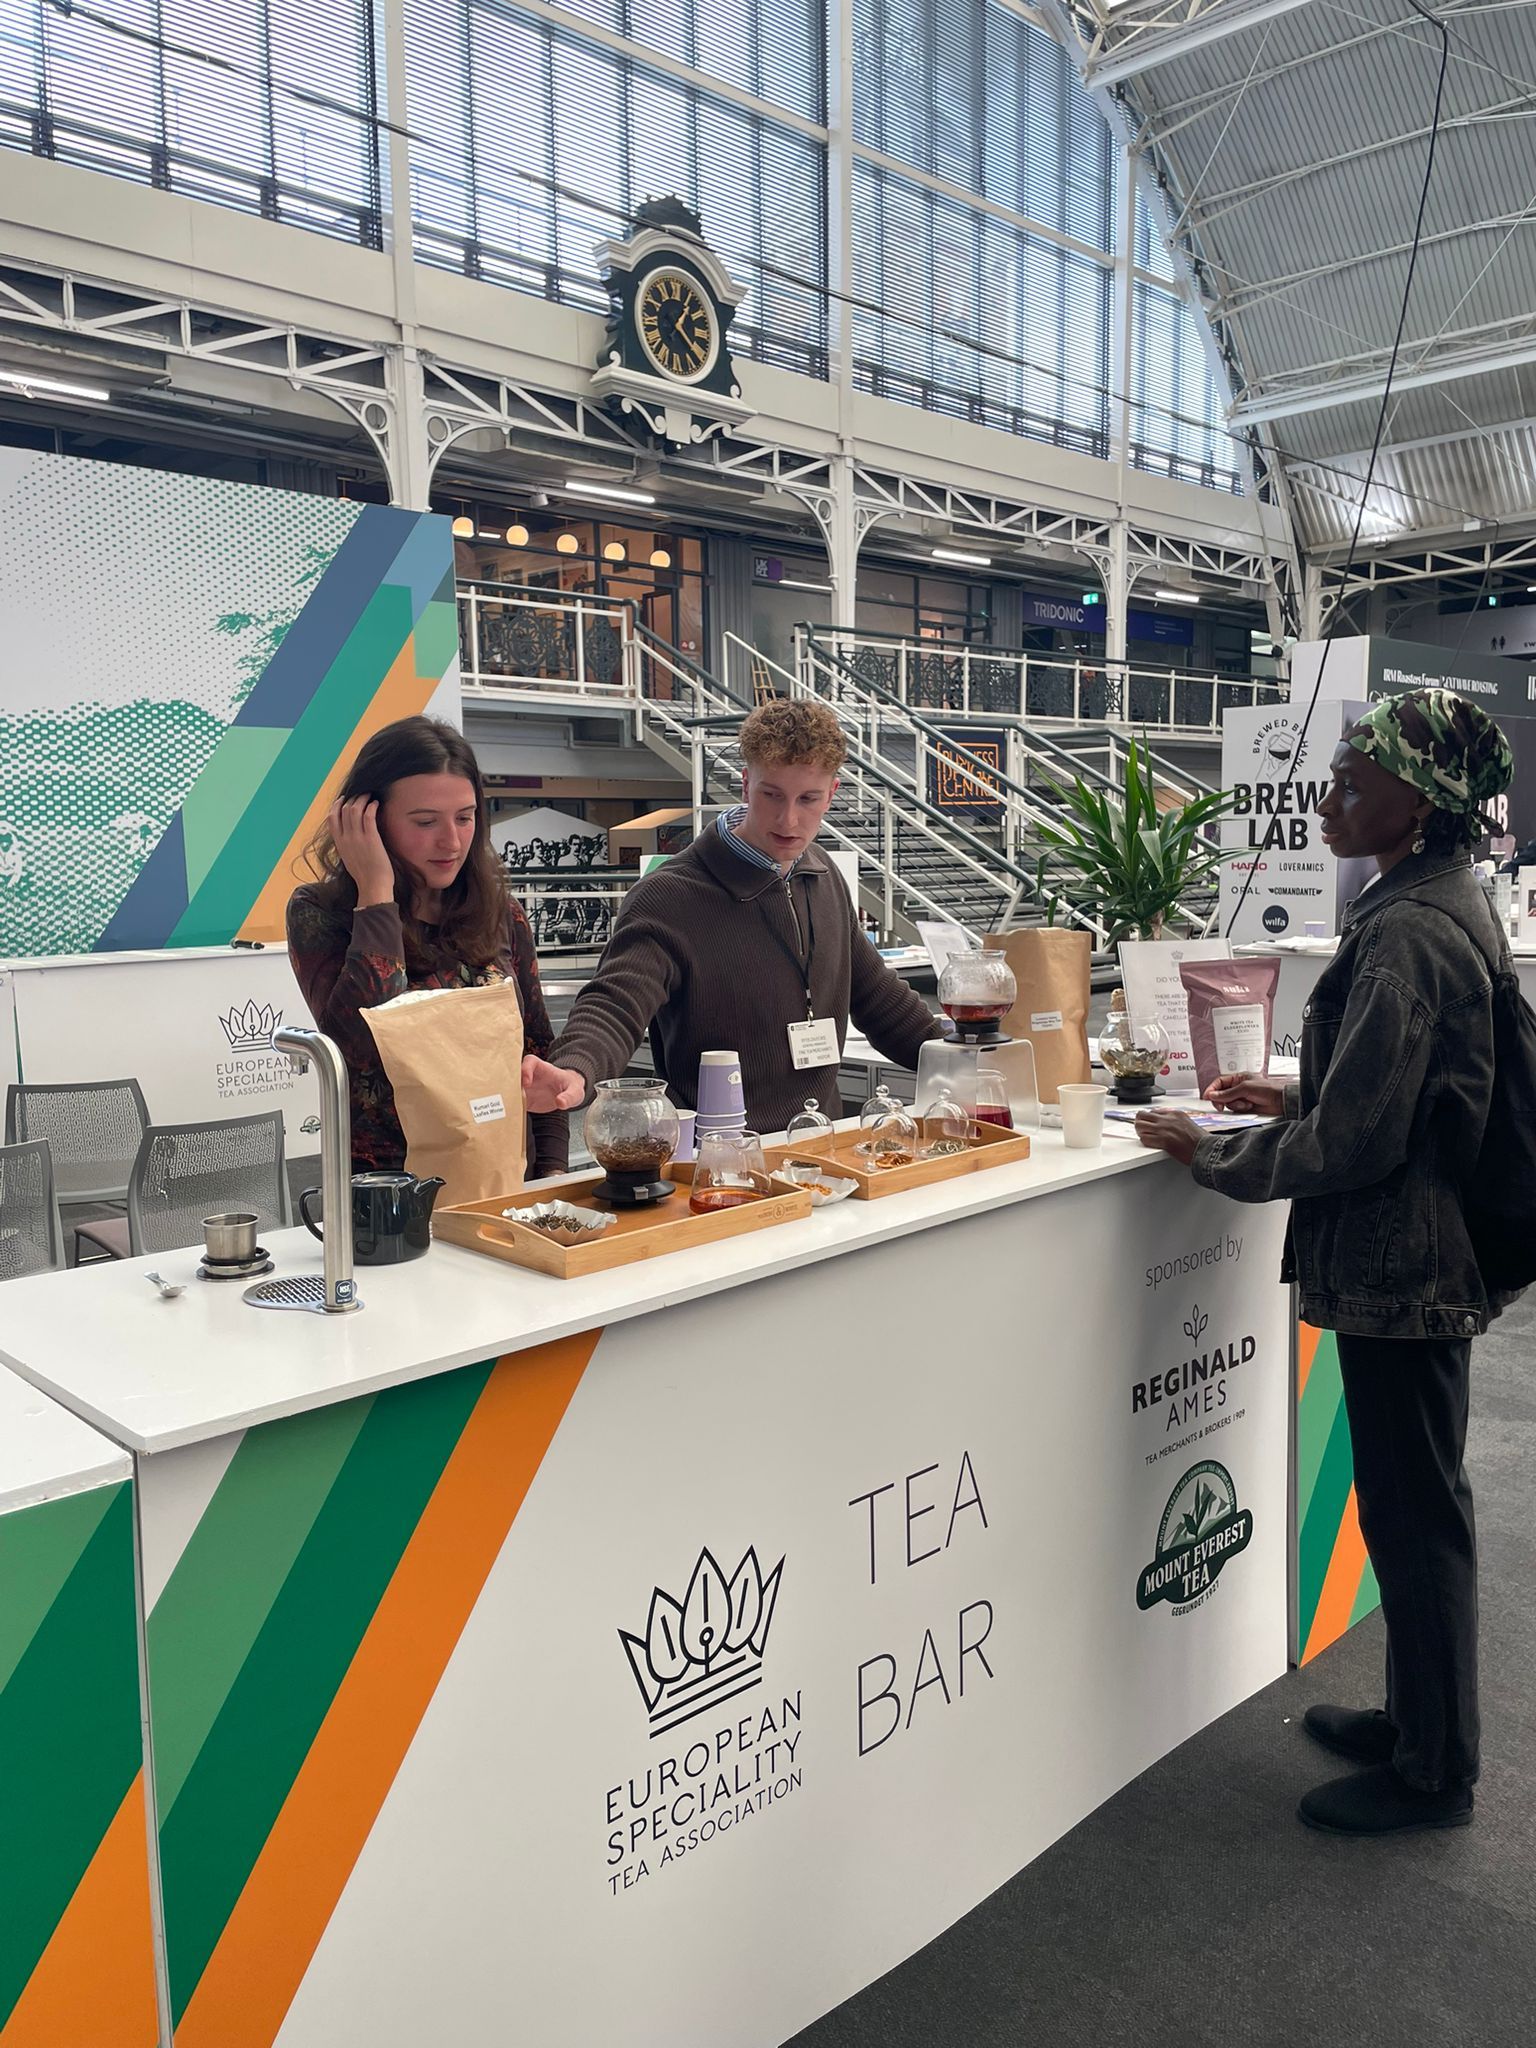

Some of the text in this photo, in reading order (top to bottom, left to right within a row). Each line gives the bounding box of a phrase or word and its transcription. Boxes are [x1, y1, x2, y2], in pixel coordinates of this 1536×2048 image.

[1033, 601, 1084, 623] TRIDONIC
[1397, 669, 1421, 685] Roasters
[1421, 673, 1439, 687] Forum
[1252, 719, 1288, 754] BREWED
[1234, 781, 1328, 815] BREW
[1248, 818, 1308, 851] LAB
[1280, 863, 1324, 873] LOVERAMICS
[1274, 887, 1316, 896] COMANDANTE
[1265, 917, 1286, 927] wilfa
[216, 1056, 291, 1075] EUROPEAN
[217, 1070, 292, 1089] SPECIALITY
[219, 1082, 294, 1099] TEA ASSOCIATION
[1146, 1235, 1243, 1290] sponsored by
[1132, 1336, 1256, 1414] REGINALD
[1166, 1379, 1227, 1432] AMES
[1145, 1453, 1158, 1467] TEA
[1159, 1432, 1197, 1459] MERCHANTS
[1205, 1416, 1231, 1436] BROKERS
[1233, 1409, 1245, 1421] 1909
[849, 1450, 988, 1585] TEA
[1145, 1518, 1246, 1597] MOUNT EVEREST
[1182, 1563, 1210, 1598] TEA
[858, 1600, 994, 1757] BAR
[606, 1690, 801, 1824] EUROPEAN
[606, 1730, 801, 1865] SPECIALITY
[608, 1768, 802, 1896] TEA ASSOCIATION
